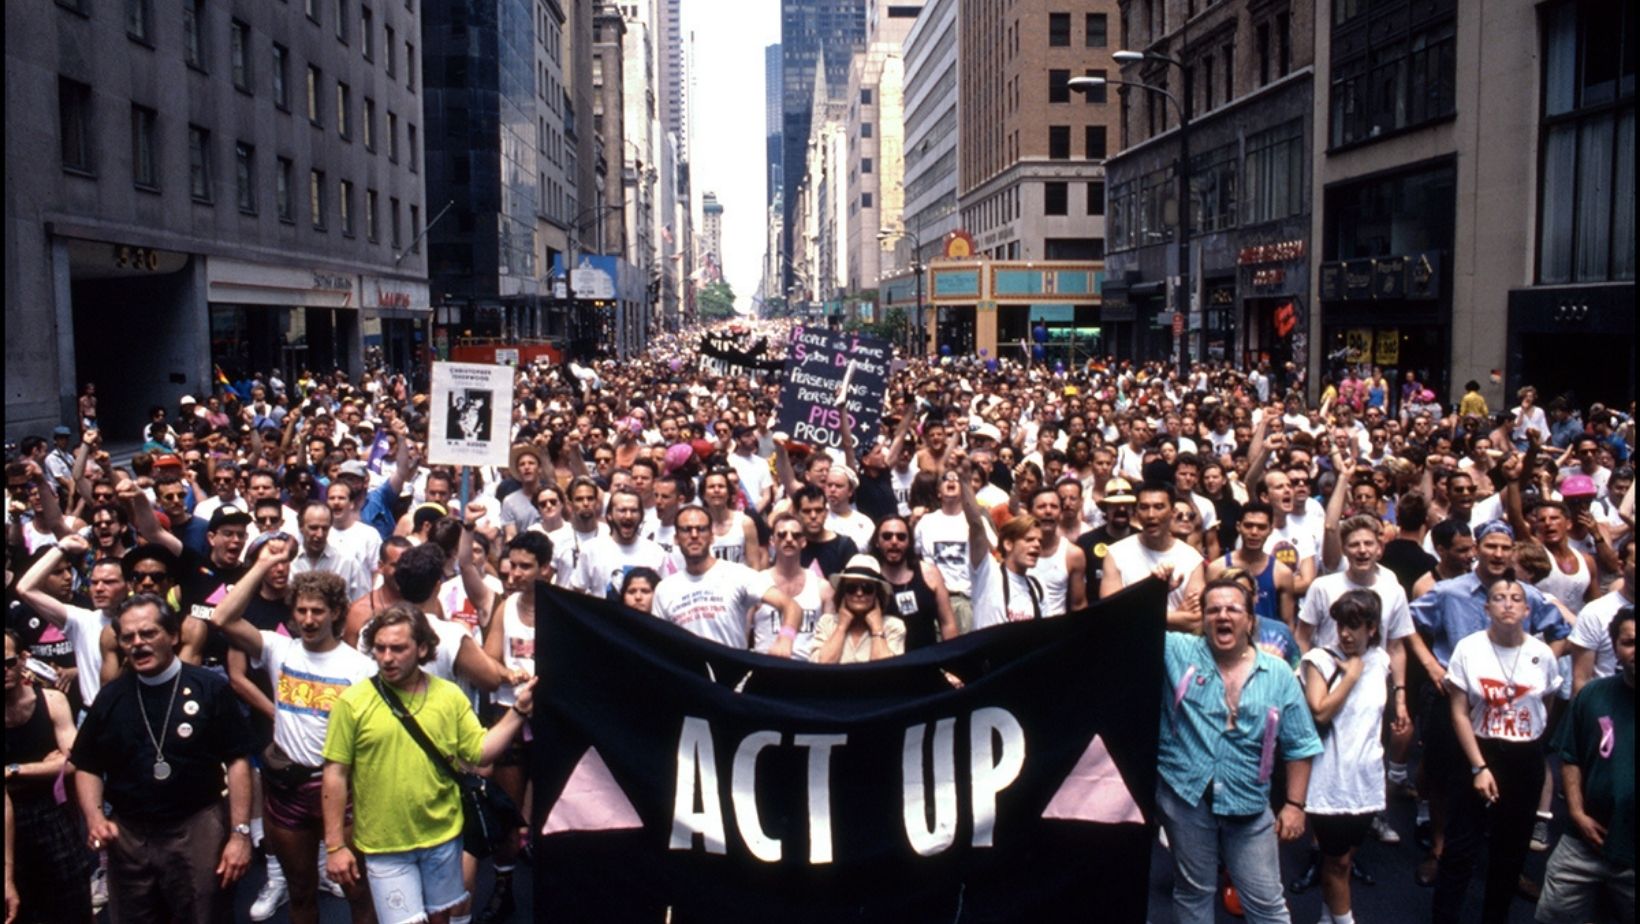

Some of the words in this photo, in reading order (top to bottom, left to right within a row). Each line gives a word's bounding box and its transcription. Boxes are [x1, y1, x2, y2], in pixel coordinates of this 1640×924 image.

[791, 366, 869, 396] PERSEVERNG
[668, 715, 848, 865] ACT
[902, 706, 1026, 857] UP
